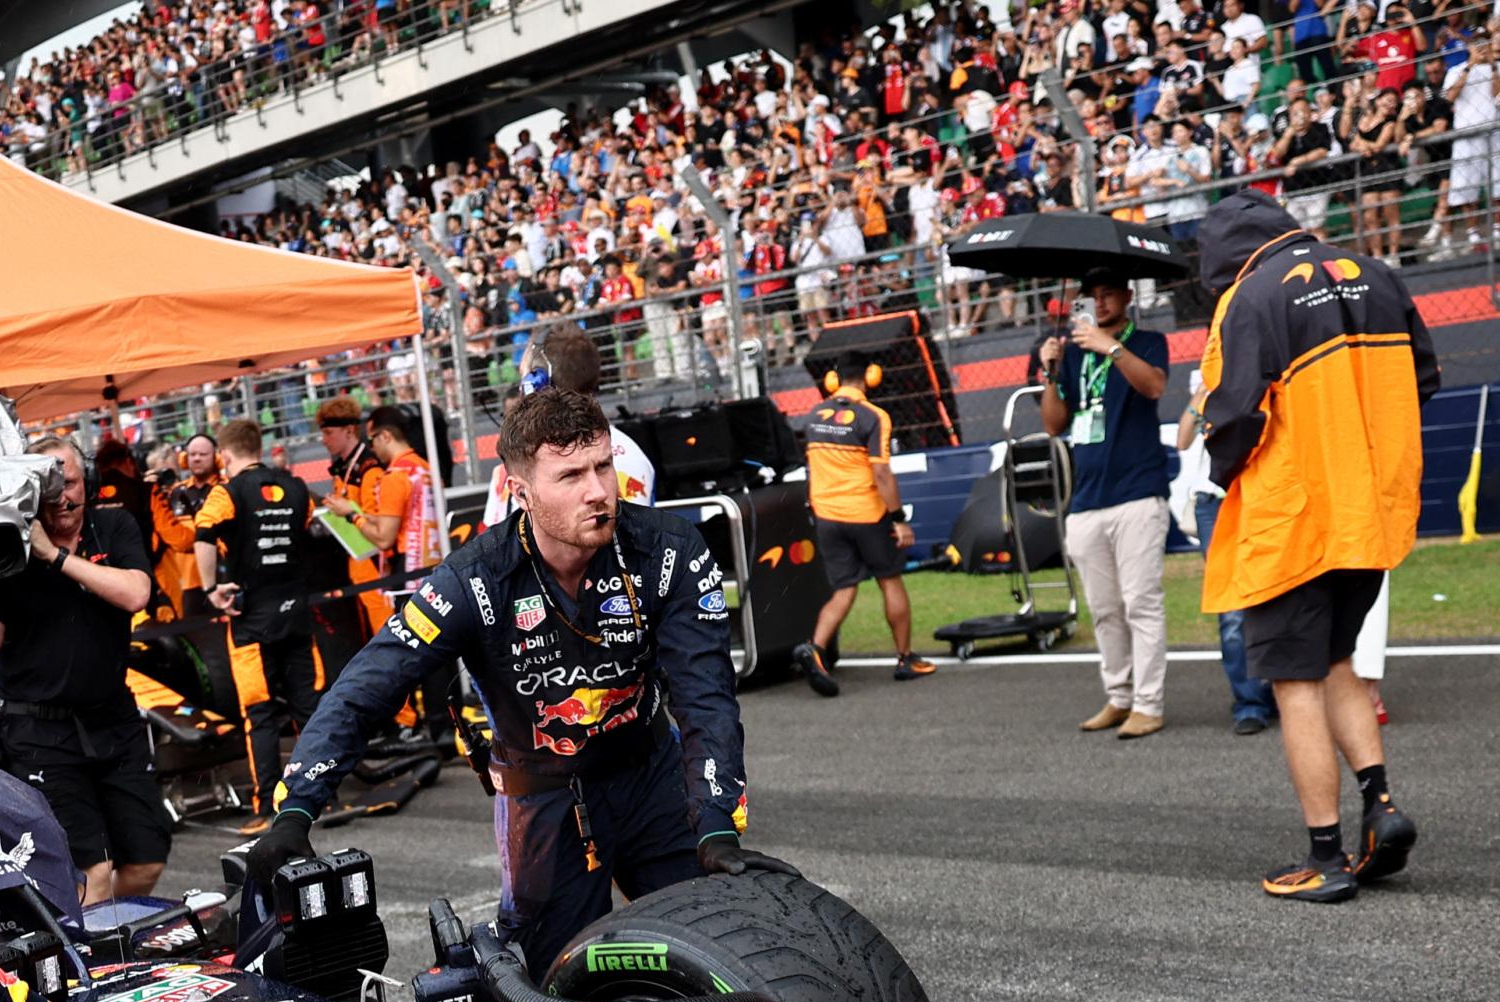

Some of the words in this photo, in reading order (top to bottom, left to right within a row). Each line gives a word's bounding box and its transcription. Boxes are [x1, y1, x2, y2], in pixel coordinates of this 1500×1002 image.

[658, 548, 677, 597] sparco
[419, 582, 453, 617] Mobil
[469, 577, 495, 626] sparco
[515, 610, 545, 629] EUER
[587, 943, 668, 972] PIRELLI
